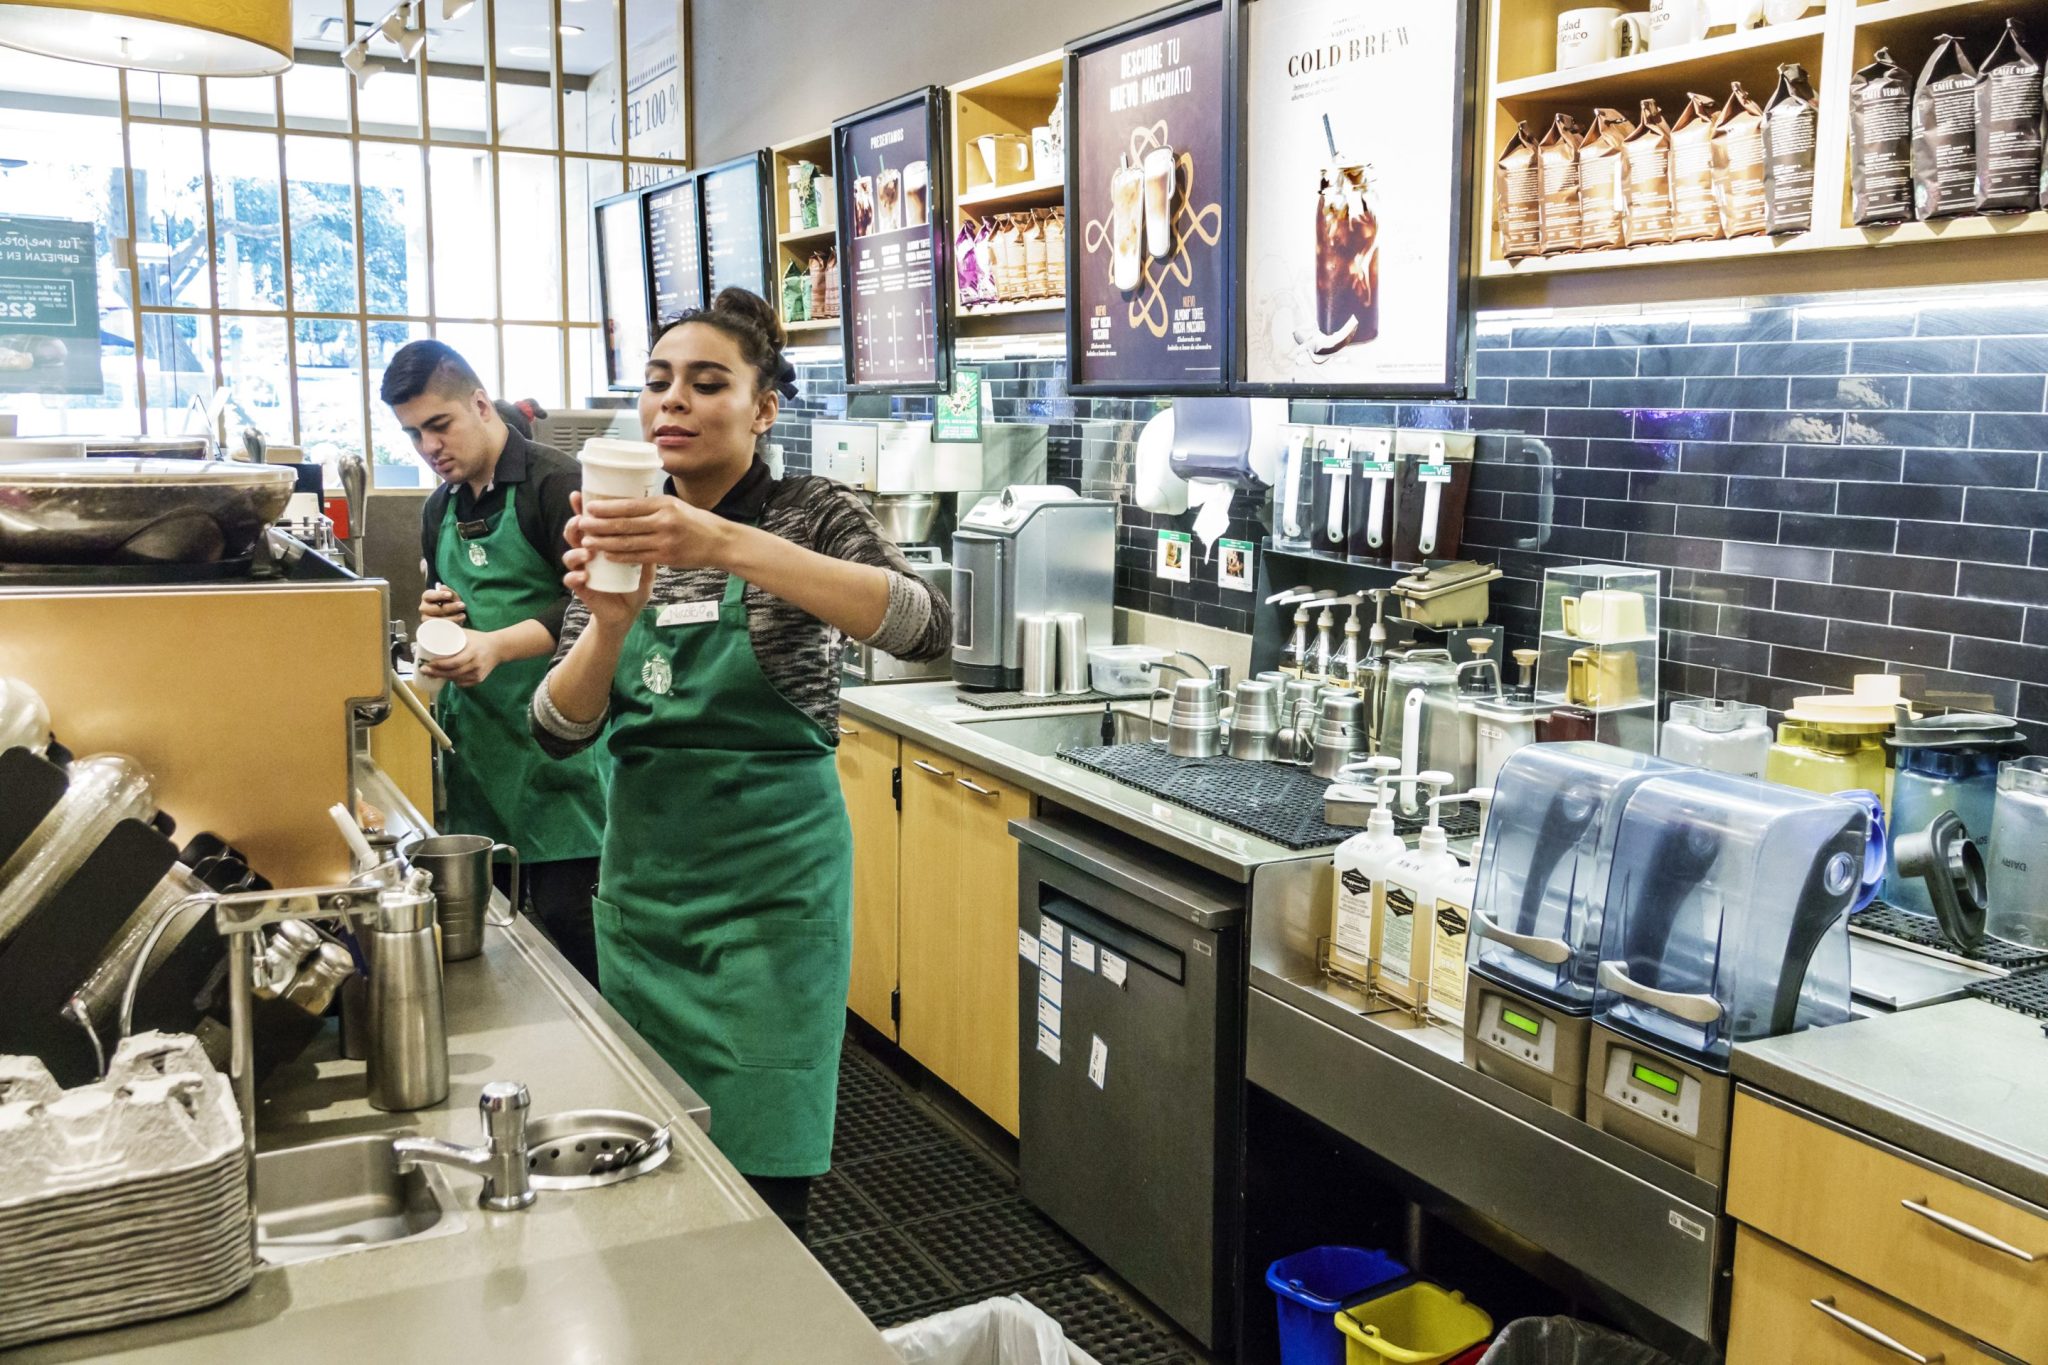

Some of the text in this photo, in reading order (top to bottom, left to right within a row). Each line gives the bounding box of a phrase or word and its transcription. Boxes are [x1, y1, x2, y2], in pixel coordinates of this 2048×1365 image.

[1121, 37, 1180, 80] DESCUBRE TU
[1288, 26, 1409, 78] COLD BREW
[645, 89, 666, 132] 100
[1110, 65, 1192, 113] NUEVO MACCHIATO
[1437, 466, 1450, 476] VIE
[2001, 857, 2027, 872] DAIRY
